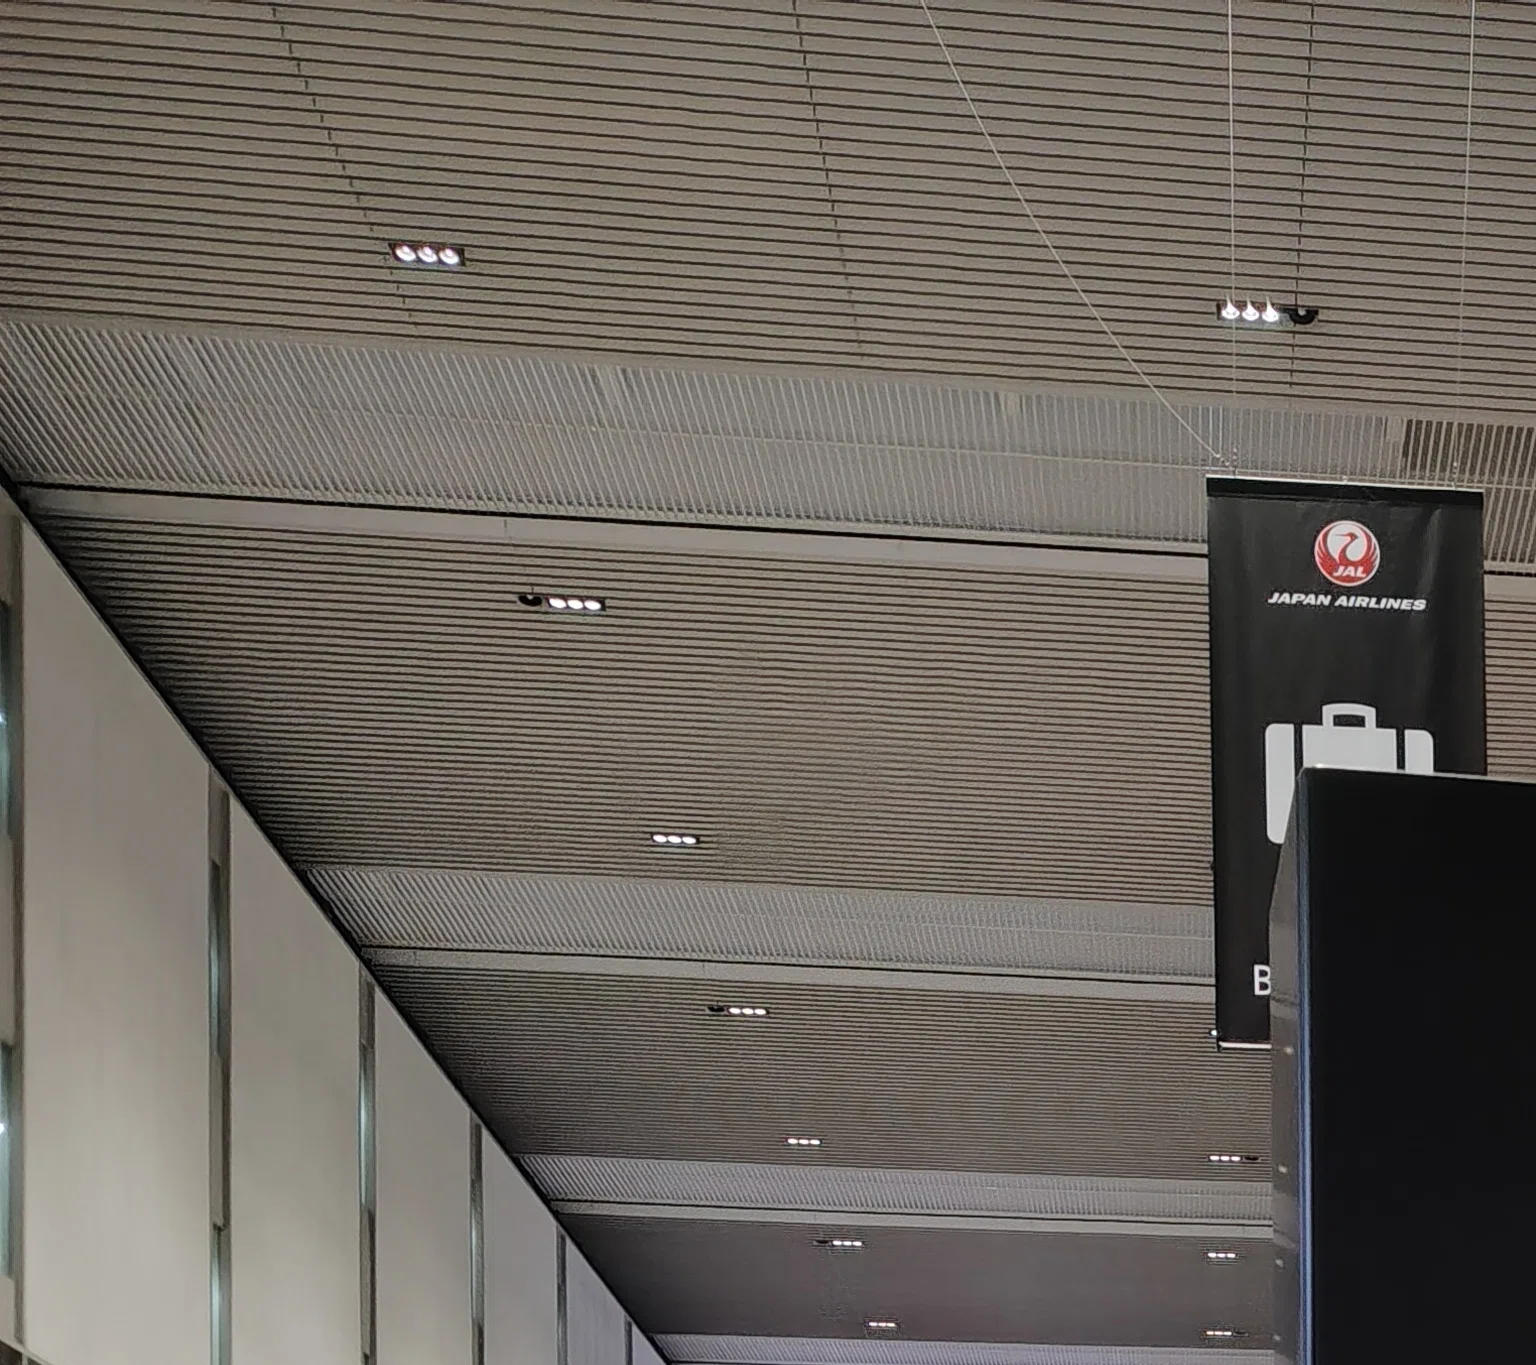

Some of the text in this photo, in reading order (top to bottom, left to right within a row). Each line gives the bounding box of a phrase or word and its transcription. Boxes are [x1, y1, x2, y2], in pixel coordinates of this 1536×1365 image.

[1333, 566, 1367, 577] JAL
[1267, 592, 1427, 611] JAPAN AIRLINES
